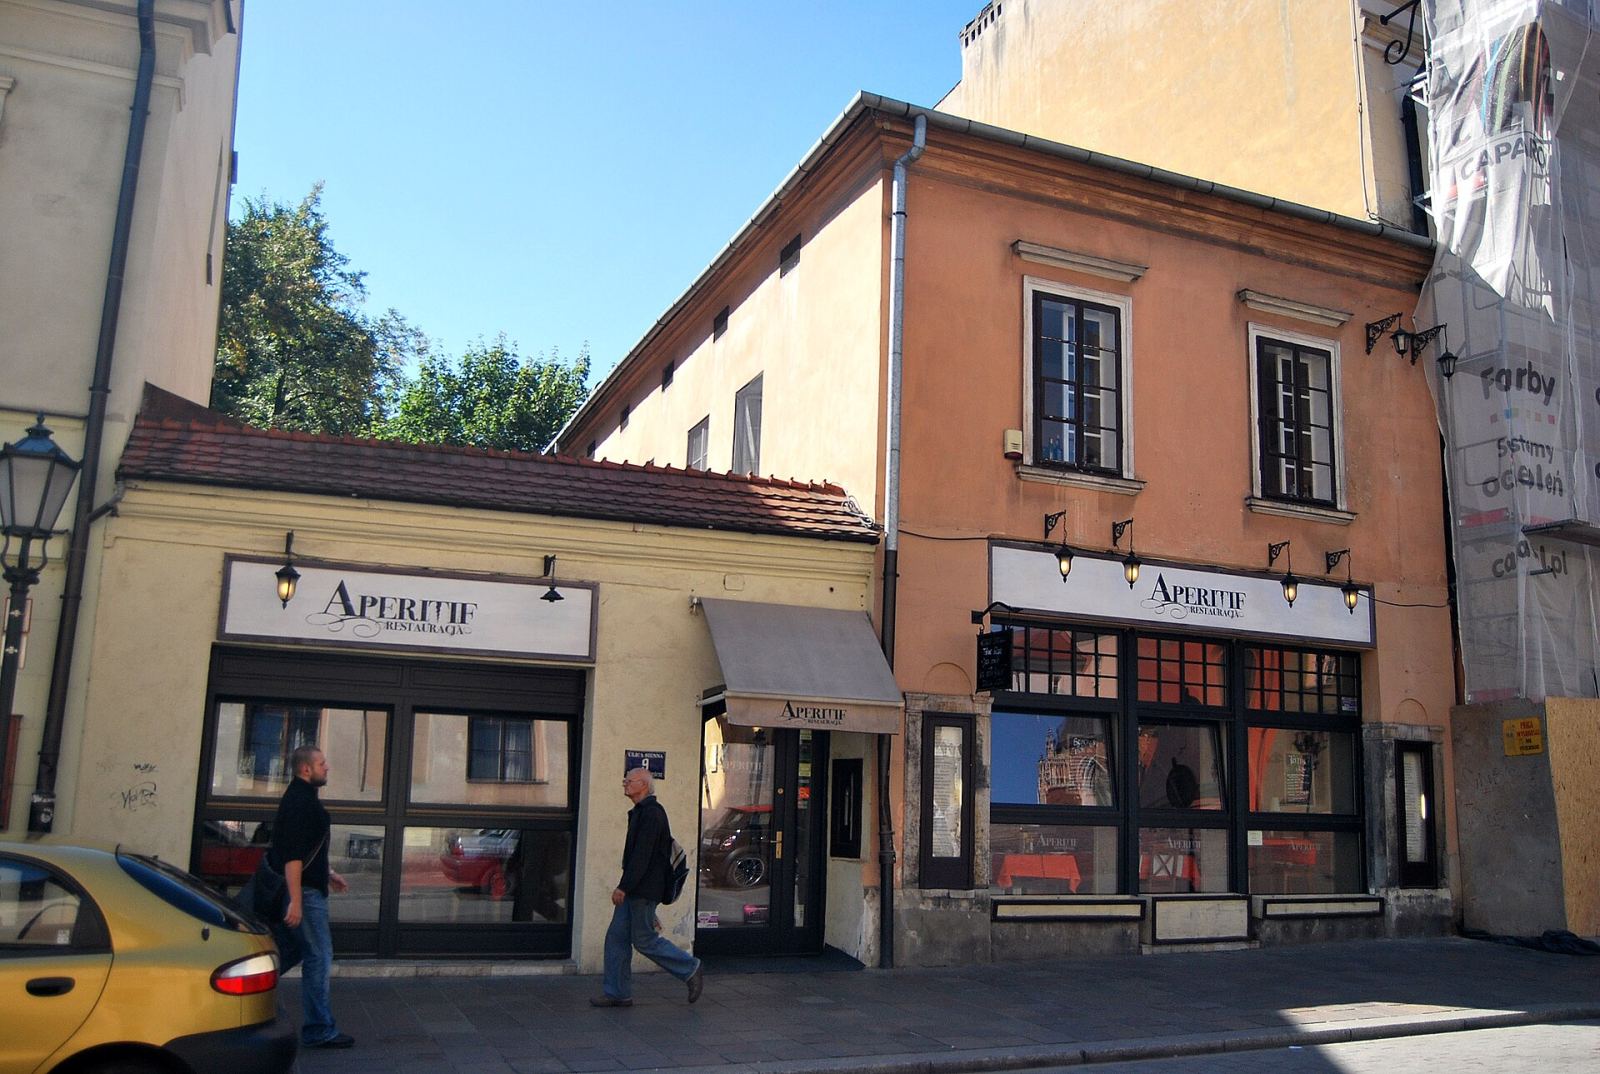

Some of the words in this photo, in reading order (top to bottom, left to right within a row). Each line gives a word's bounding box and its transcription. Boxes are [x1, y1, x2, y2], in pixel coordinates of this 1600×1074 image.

[1151, 572, 1247, 610] APERITIF
[324, 579, 478, 625] APERITIF
[1189, 605, 1240, 619] RESTAURACJA
[385, 620, 465, 636] RESTAURACJA
[780, 700, 847, 720] APERITIF
[641, 758, 650, 770] 9
